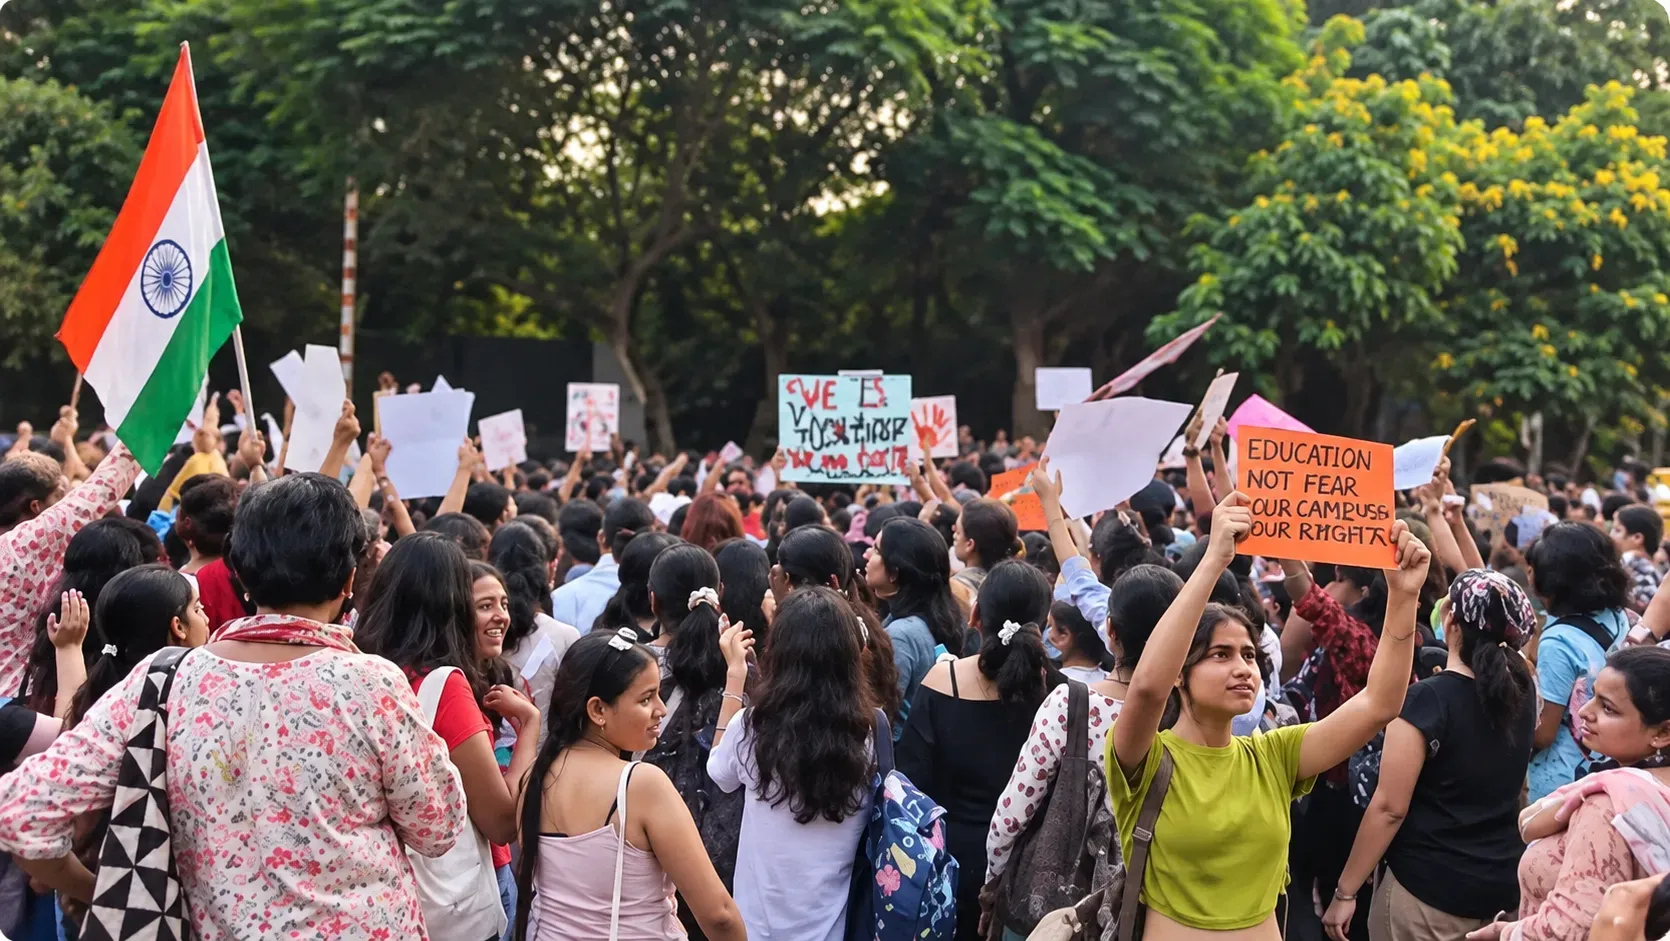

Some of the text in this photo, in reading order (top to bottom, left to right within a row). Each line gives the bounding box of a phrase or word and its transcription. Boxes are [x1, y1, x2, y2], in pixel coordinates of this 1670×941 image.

[1248, 438, 1372, 471] EDUCATION
[1247, 469, 1359, 497] NOT FEAR
[1252, 498, 1292, 517] OUR
[1250, 520, 1292, 539] OUR
